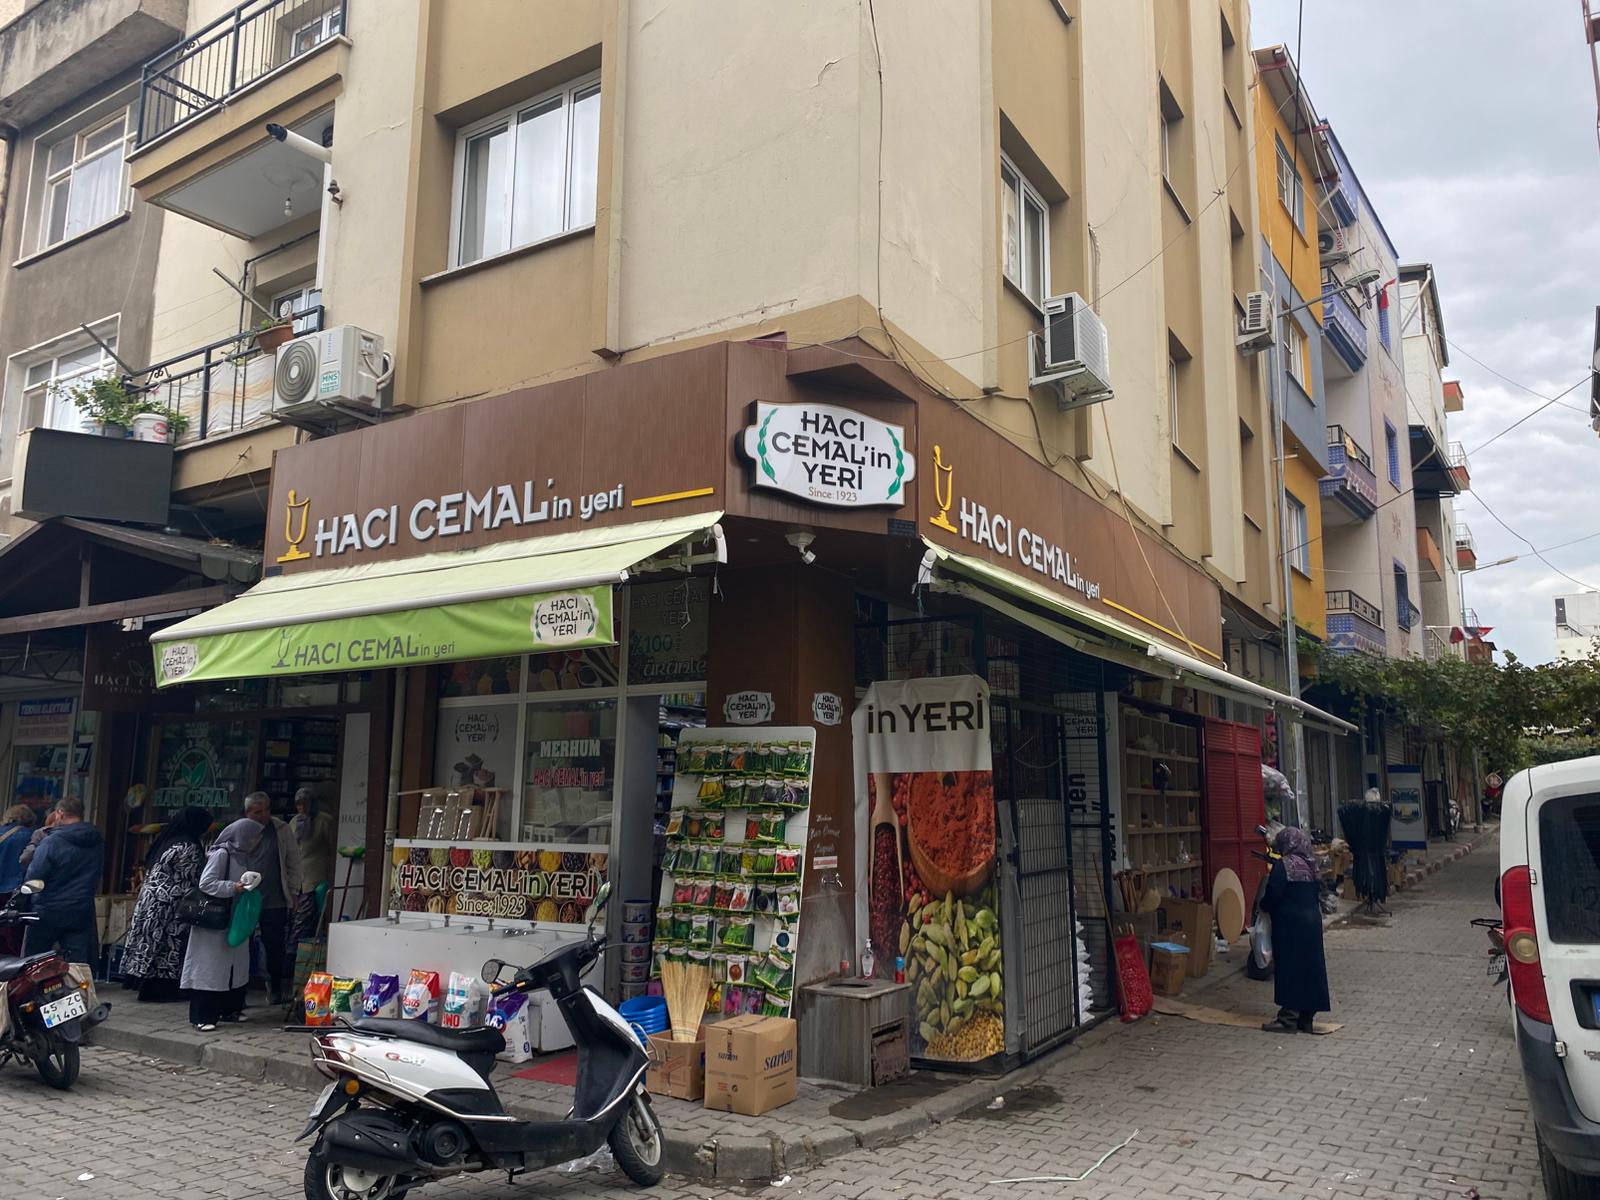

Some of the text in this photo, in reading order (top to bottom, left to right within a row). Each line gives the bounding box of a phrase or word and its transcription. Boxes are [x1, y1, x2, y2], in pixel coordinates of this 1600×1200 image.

[801, 411, 865, 442] HACI
[771, 431, 892, 469] CEMAL'in
[802, 461, 863, 490] YERİ
[315, 504, 399, 556] HACI
[580, 484, 625, 521] yeri
[960, 496, 1013, 557] HACI
[1085, 580, 1100, 600] yeri
[550, 597, 579, 612] HACI
[540, 609, 591, 626] CEMAL'in
[552, 622, 577, 637] YERİ
[293, 642, 342, 667] HACI
[433, 641, 456, 659] yeri
[739, 694, 758, 703] HACI
[822, 695, 835, 704] HACI
[868, 693, 985, 734] in YERİ
[540, 739, 601, 758] MERHUM
[401, 864, 446, 890] HACI
[543, 867, 596, 899] YERİ
[43, 994, 81, 1015] 45 ZC
[57, 1005, 84, 1022] 1401
[764, 1049, 794, 1072] sarten
